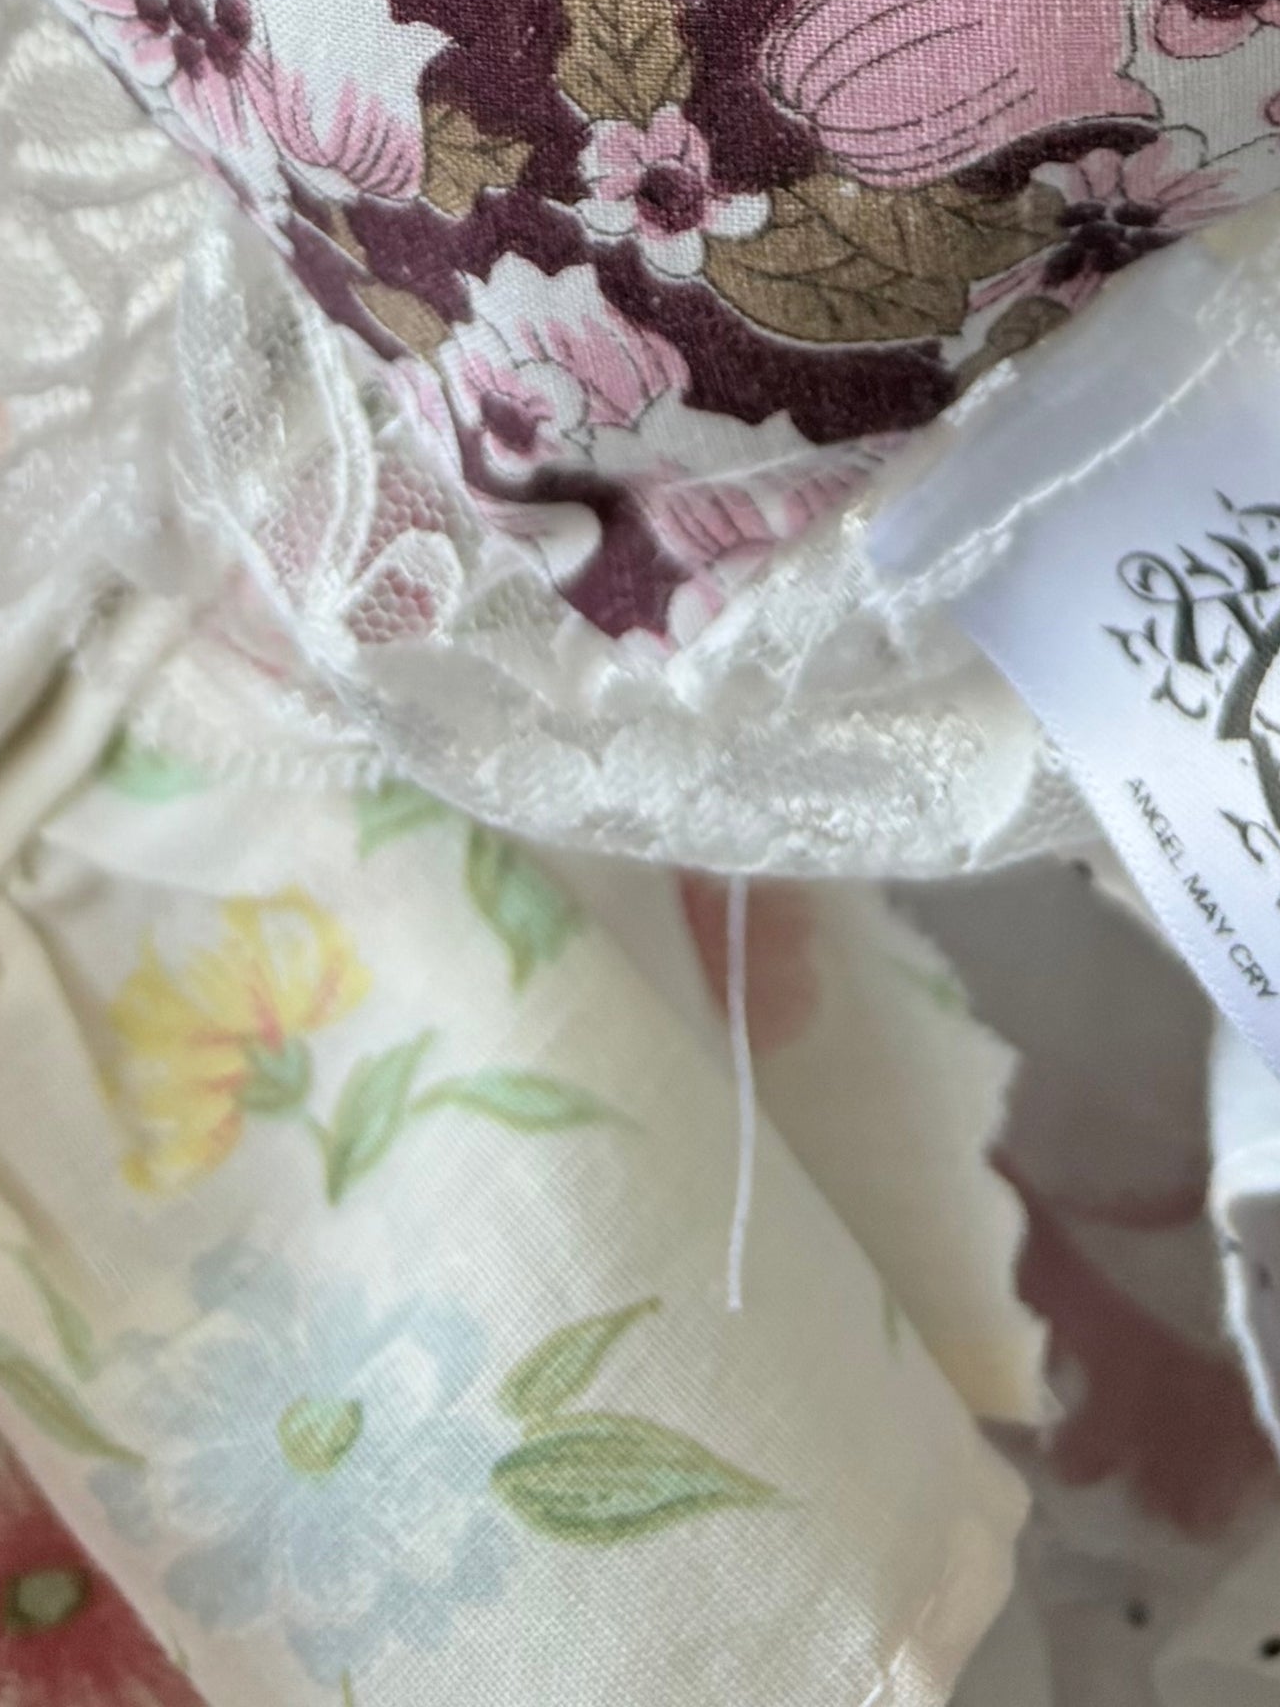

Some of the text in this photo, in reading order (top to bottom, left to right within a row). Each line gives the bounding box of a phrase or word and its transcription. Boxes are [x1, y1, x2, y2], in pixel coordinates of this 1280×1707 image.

[1125, 778, 1279, 996] ANGEL MAY CRY
